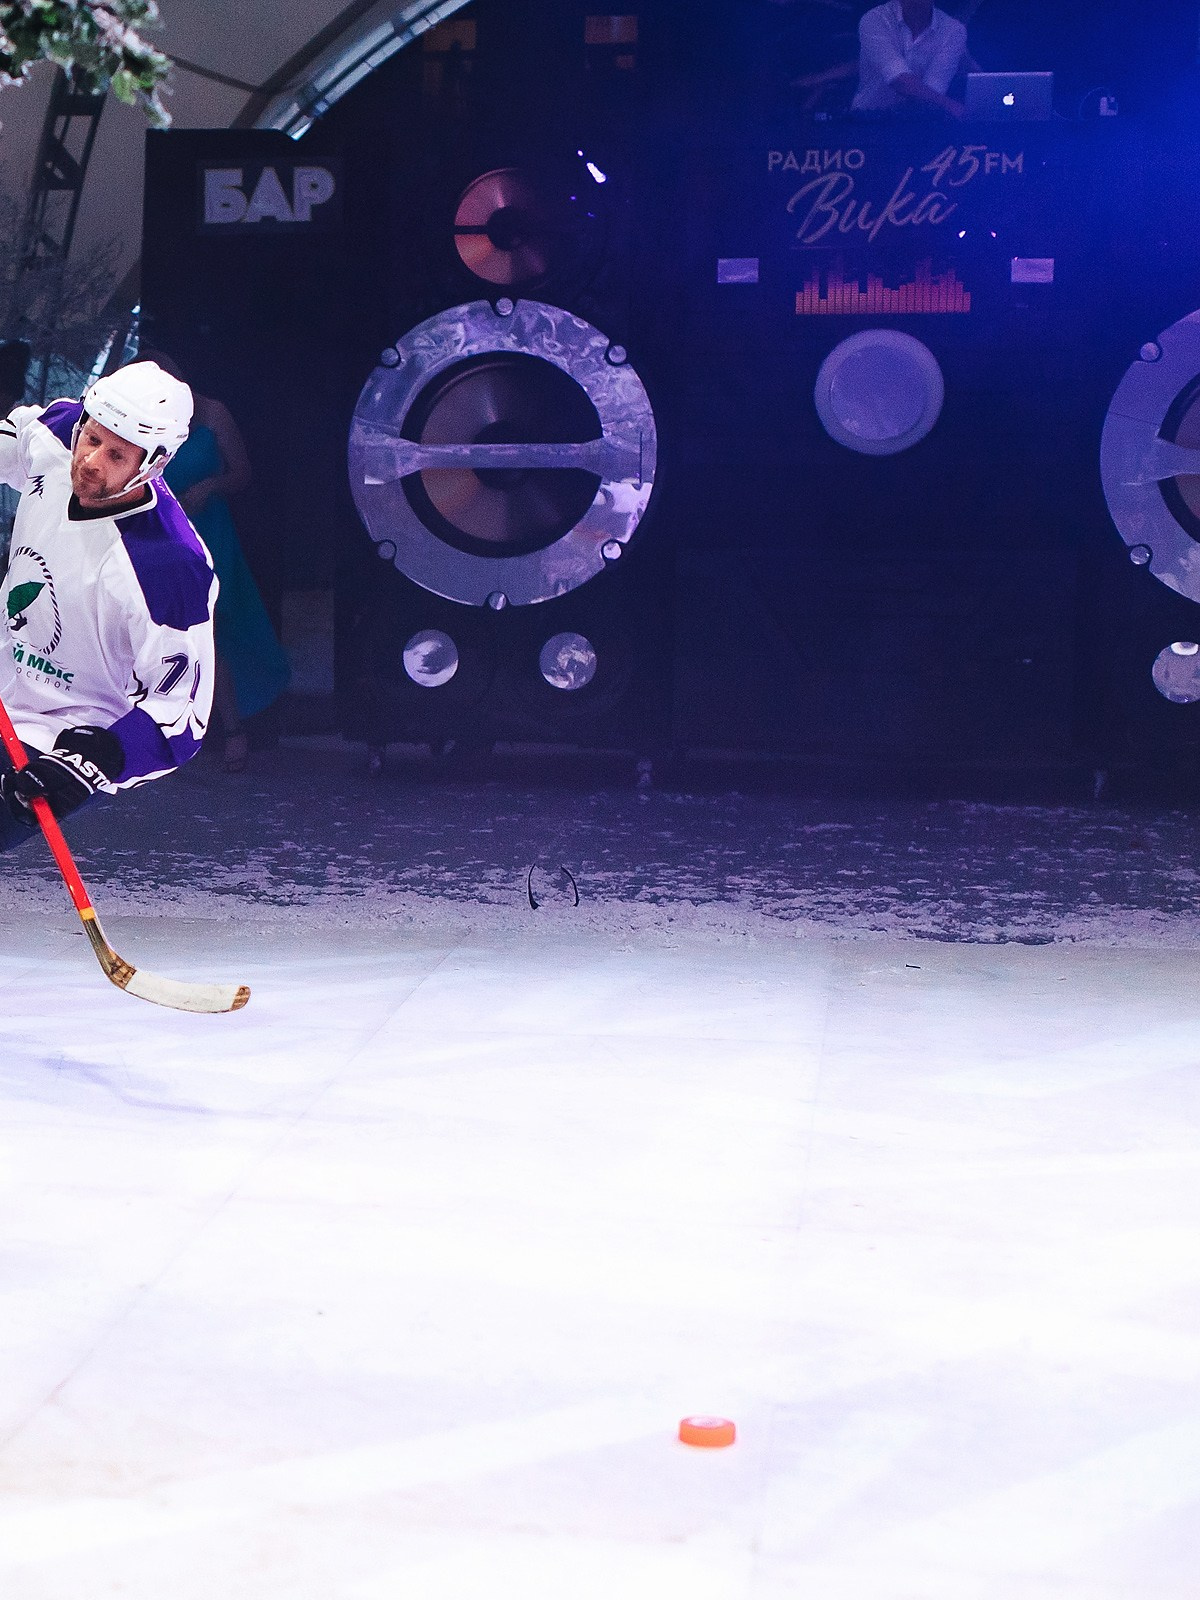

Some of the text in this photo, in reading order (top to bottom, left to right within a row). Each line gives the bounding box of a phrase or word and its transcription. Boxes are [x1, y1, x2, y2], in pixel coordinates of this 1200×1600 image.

[767, 149, 865, 174] РАДИО
[204, 166, 336, 223] БАР
[786, 166, 958, 243] Вика
